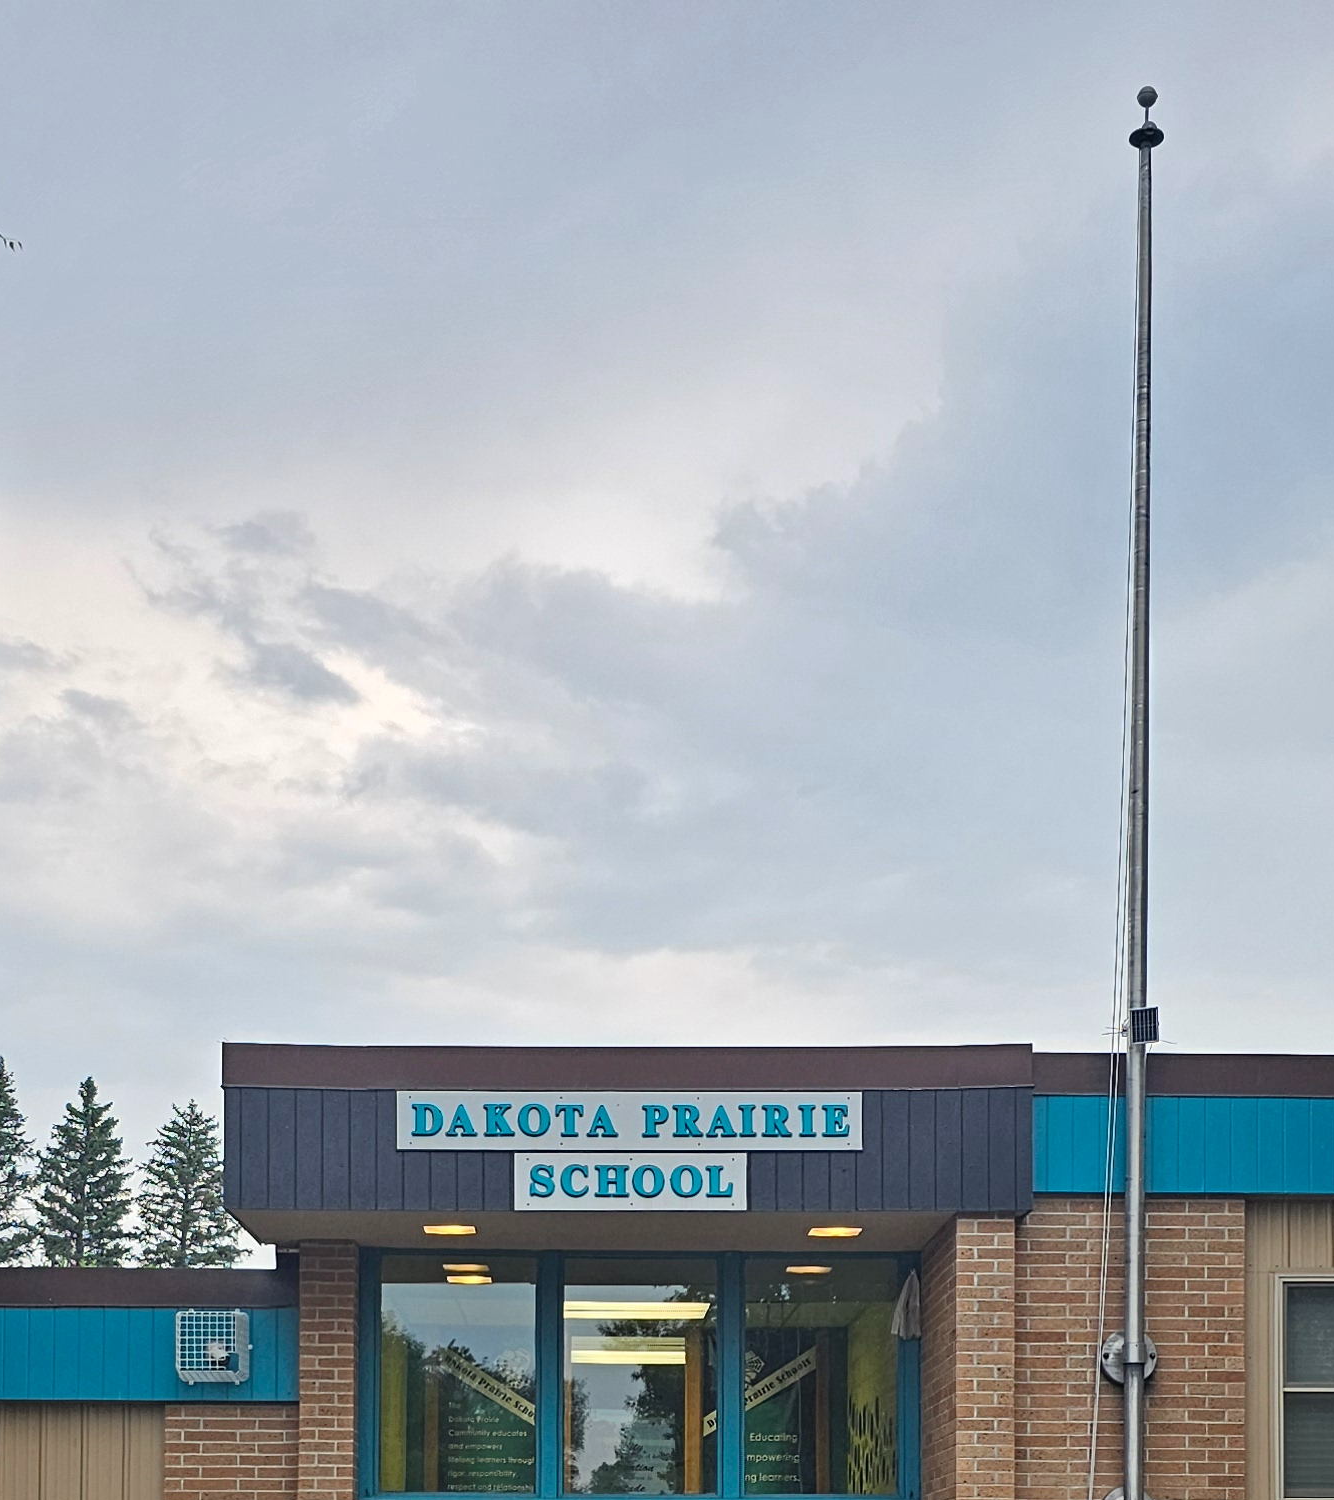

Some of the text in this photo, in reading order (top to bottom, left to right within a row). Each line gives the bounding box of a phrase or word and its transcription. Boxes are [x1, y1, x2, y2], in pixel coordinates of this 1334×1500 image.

[410, 1103, 852, 1138] DAKOTA PRAIRIE
[529, 1164, 735, 1199] SCHOOL
[492, 1430, 528, 1438] educates
[749, 1433, 798, 1443] Educating
